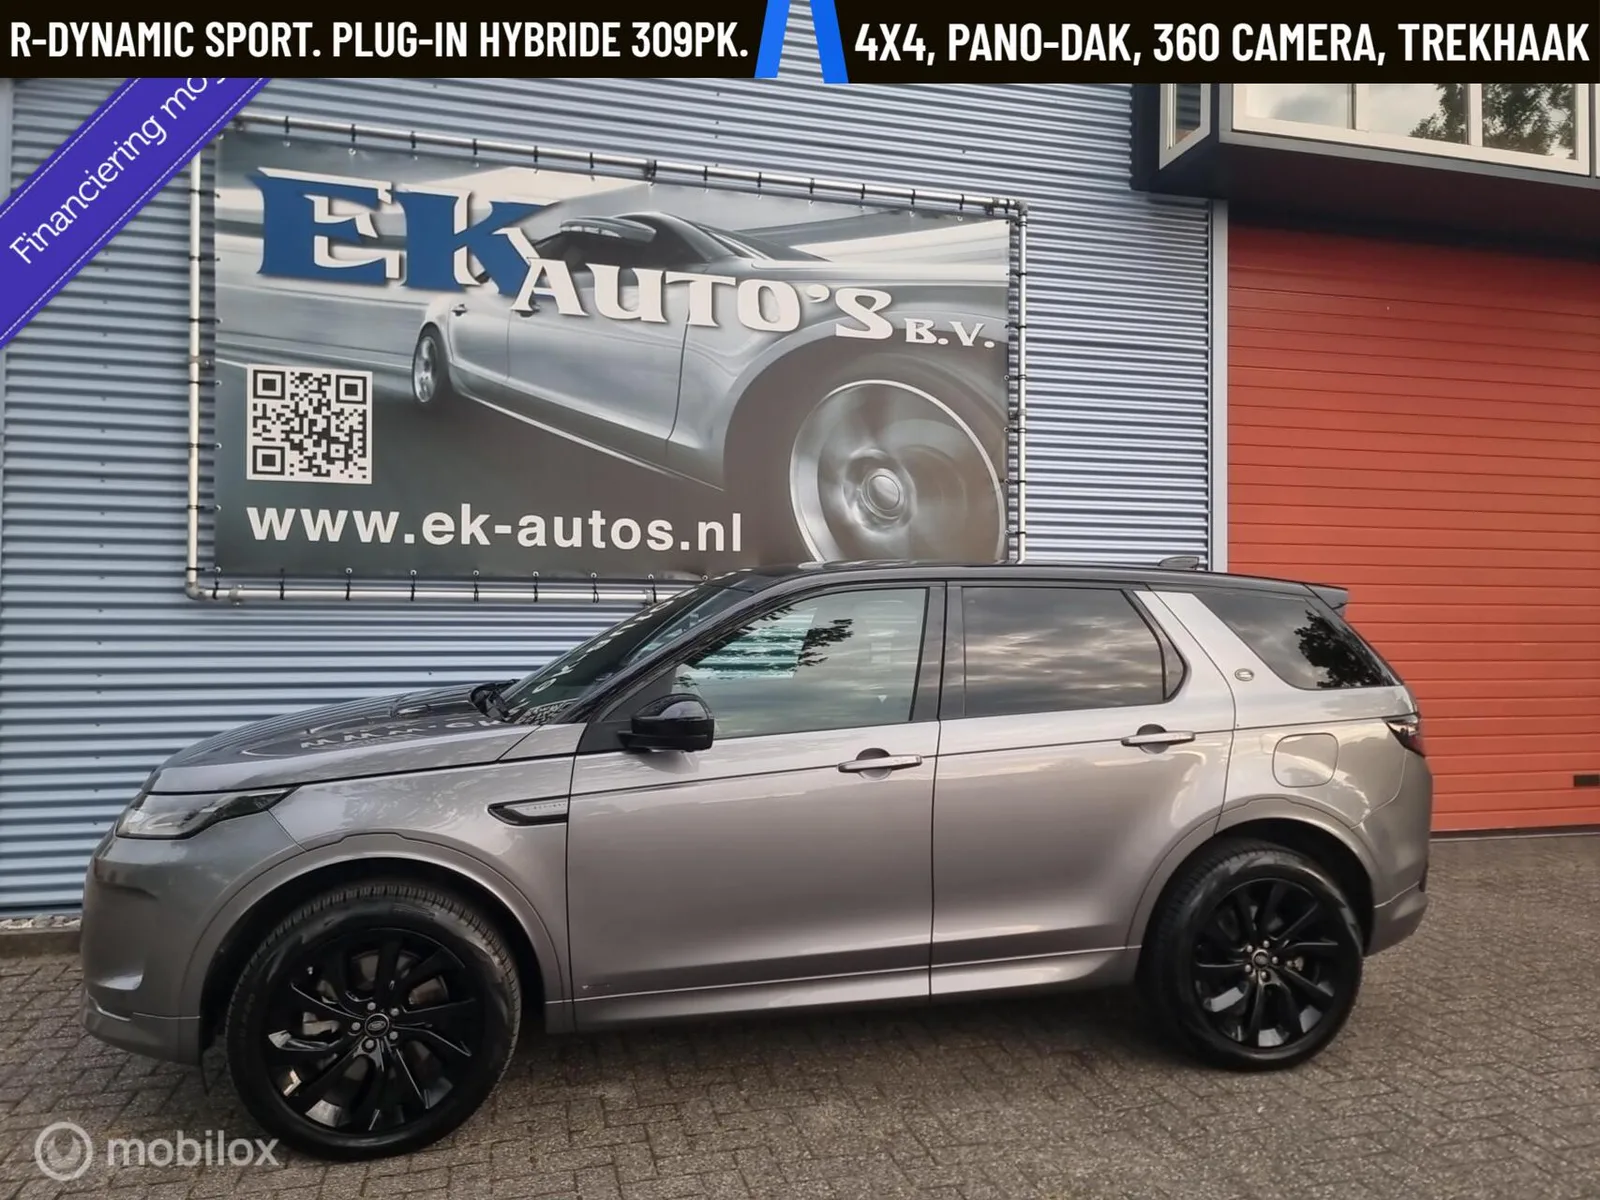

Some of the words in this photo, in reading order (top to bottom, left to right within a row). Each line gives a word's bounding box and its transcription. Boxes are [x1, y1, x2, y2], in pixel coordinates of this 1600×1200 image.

[246, 167, 562, 298] EK
[903, 317, 996, 349] B.V.
[246, 503, 742, 553] www.ek-autos.nl
